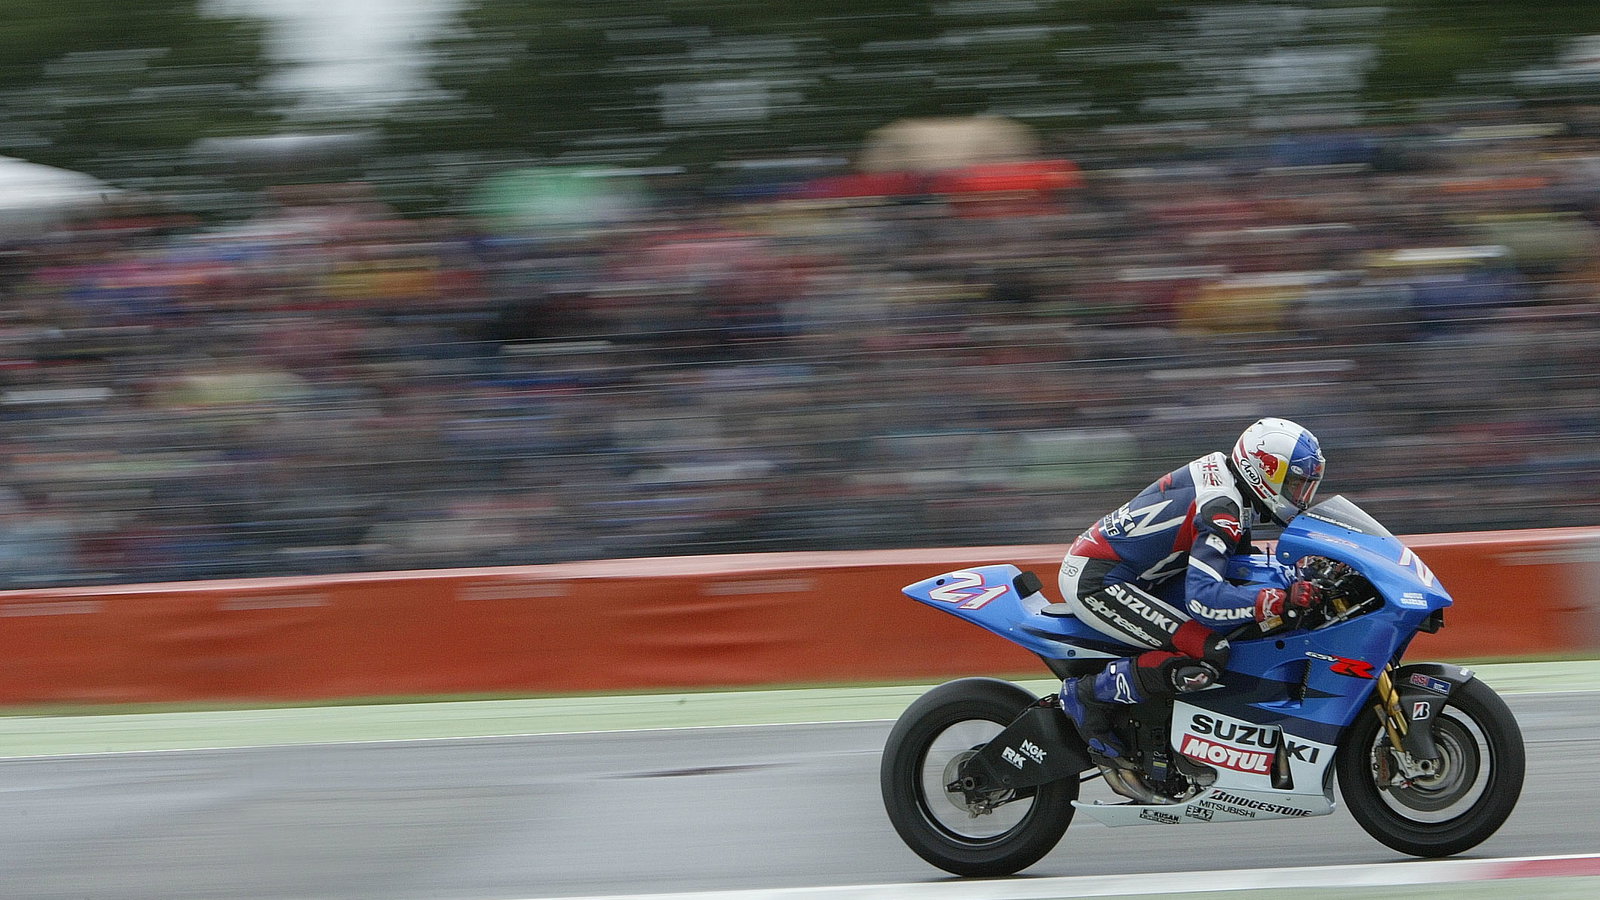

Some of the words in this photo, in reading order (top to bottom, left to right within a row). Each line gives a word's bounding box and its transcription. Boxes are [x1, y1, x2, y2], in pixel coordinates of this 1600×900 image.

[928, 571, 1010, 610] 21
[1085, 597, 1162, 647] alpinestars
[1104, 584, 1179, 634] SUZUKI
[1021, 739, 1047, 761] NGK
[1183, 738, 1268, 772] MOTUL
[1190, 714, 1320, 764] SUZUKI
[1002, 746, 1027, 768] RK
[1199, 800, 1256, 818] MITSUBISHI
[1209, 790, 1313, 817] BRIDGESTONE
